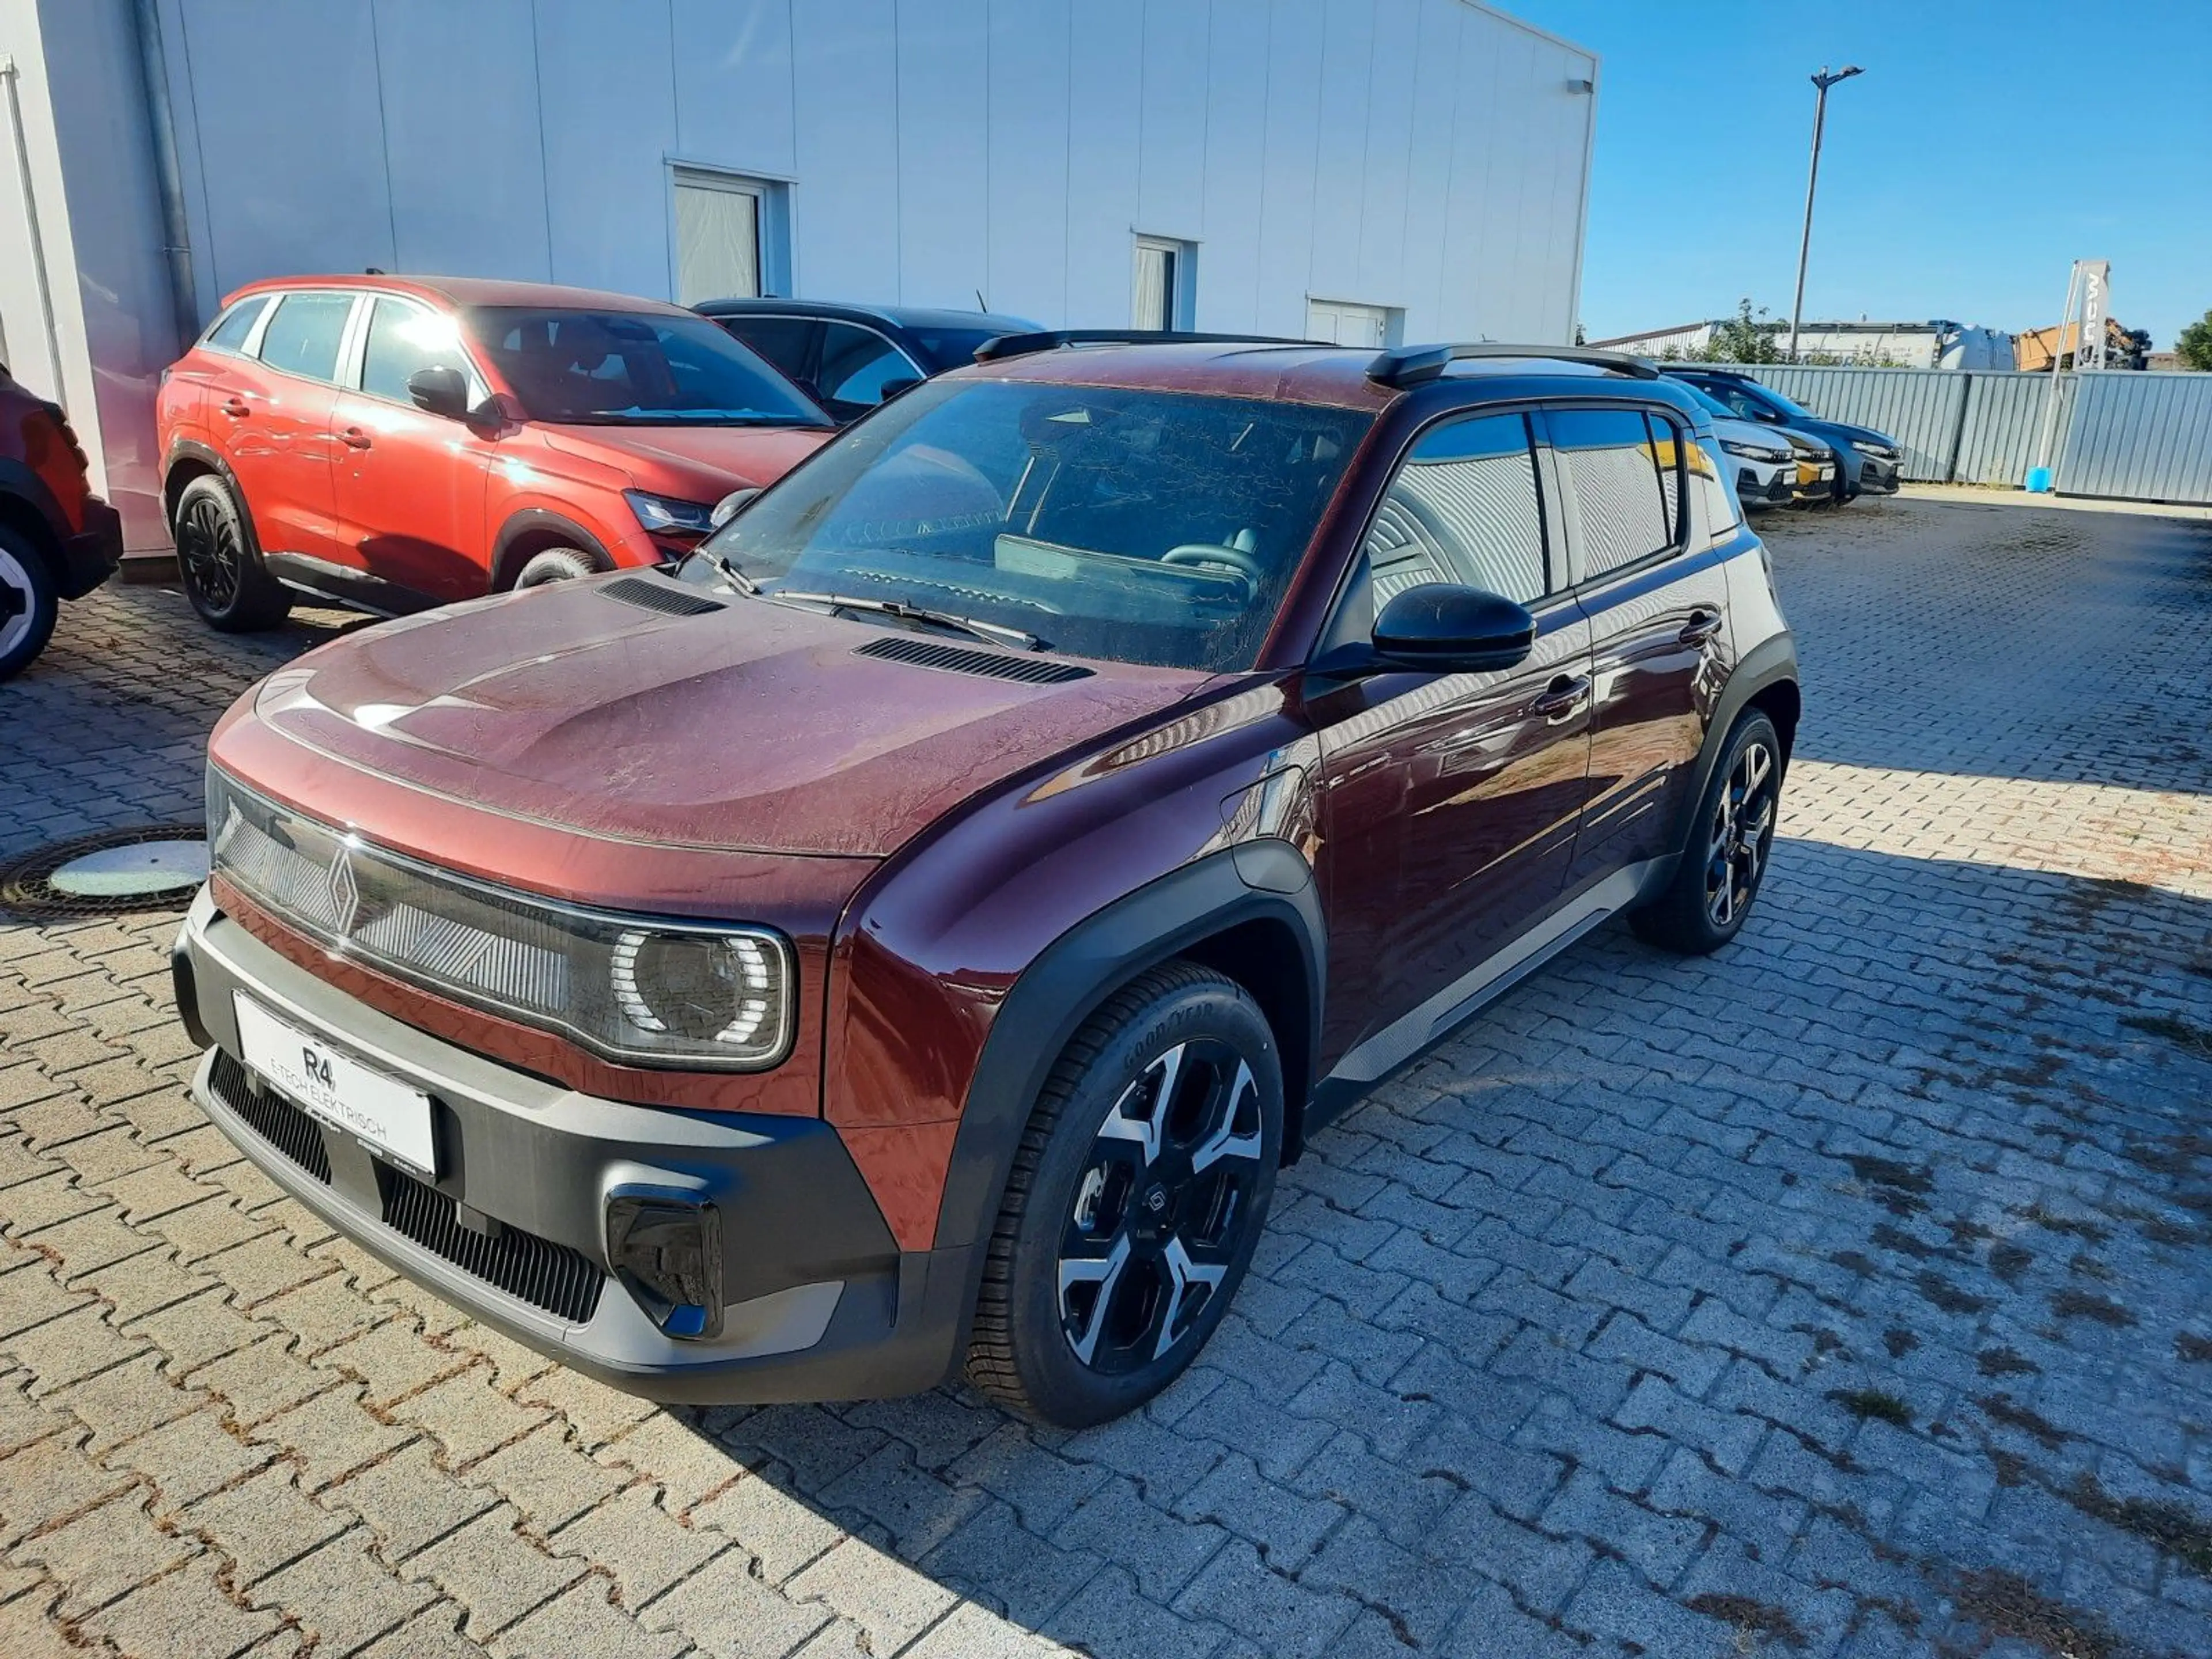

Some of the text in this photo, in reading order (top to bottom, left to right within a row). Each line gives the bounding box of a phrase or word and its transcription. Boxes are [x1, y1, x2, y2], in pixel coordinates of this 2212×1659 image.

[271, 1058, 308, 1093] E-TECH
[310, 1085, 387, 1141] ELEKTRISCH
[302, 1046, 335, 1090] R4
